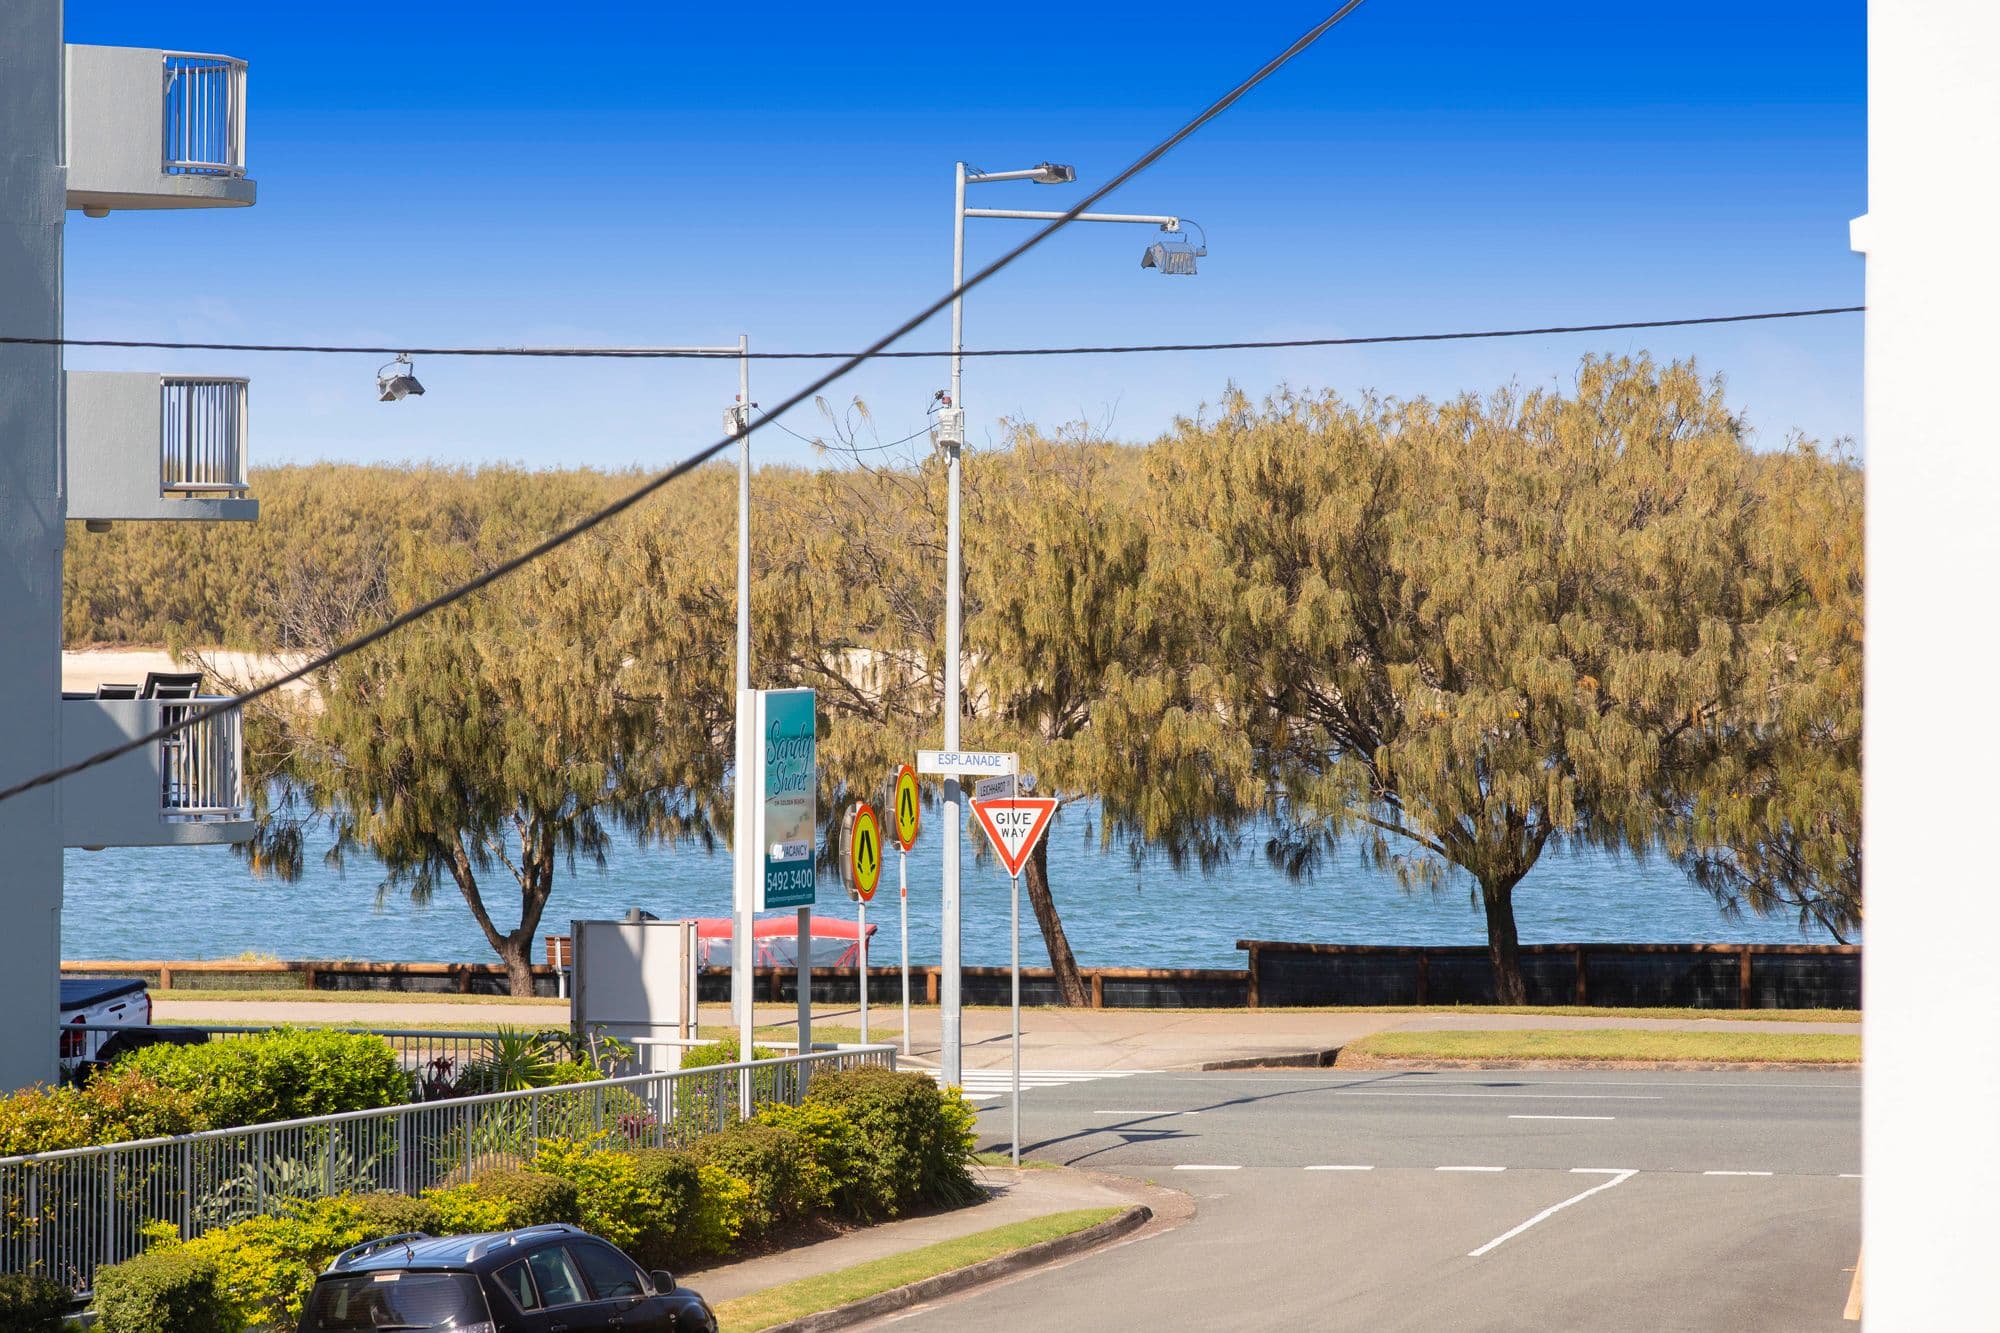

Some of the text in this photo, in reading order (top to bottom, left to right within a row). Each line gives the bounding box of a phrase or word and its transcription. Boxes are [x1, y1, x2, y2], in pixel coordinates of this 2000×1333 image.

[767, 720, 812, 774] Sandy
[938, 754, 1002, 767] ESPLANADE
[774, 761, 807, 795] Shores
[996, 812, 1032, 825] GIVE
[1001, 828, 1026, 838] WAY
[768, 869, 812, 892] 5492 3400
